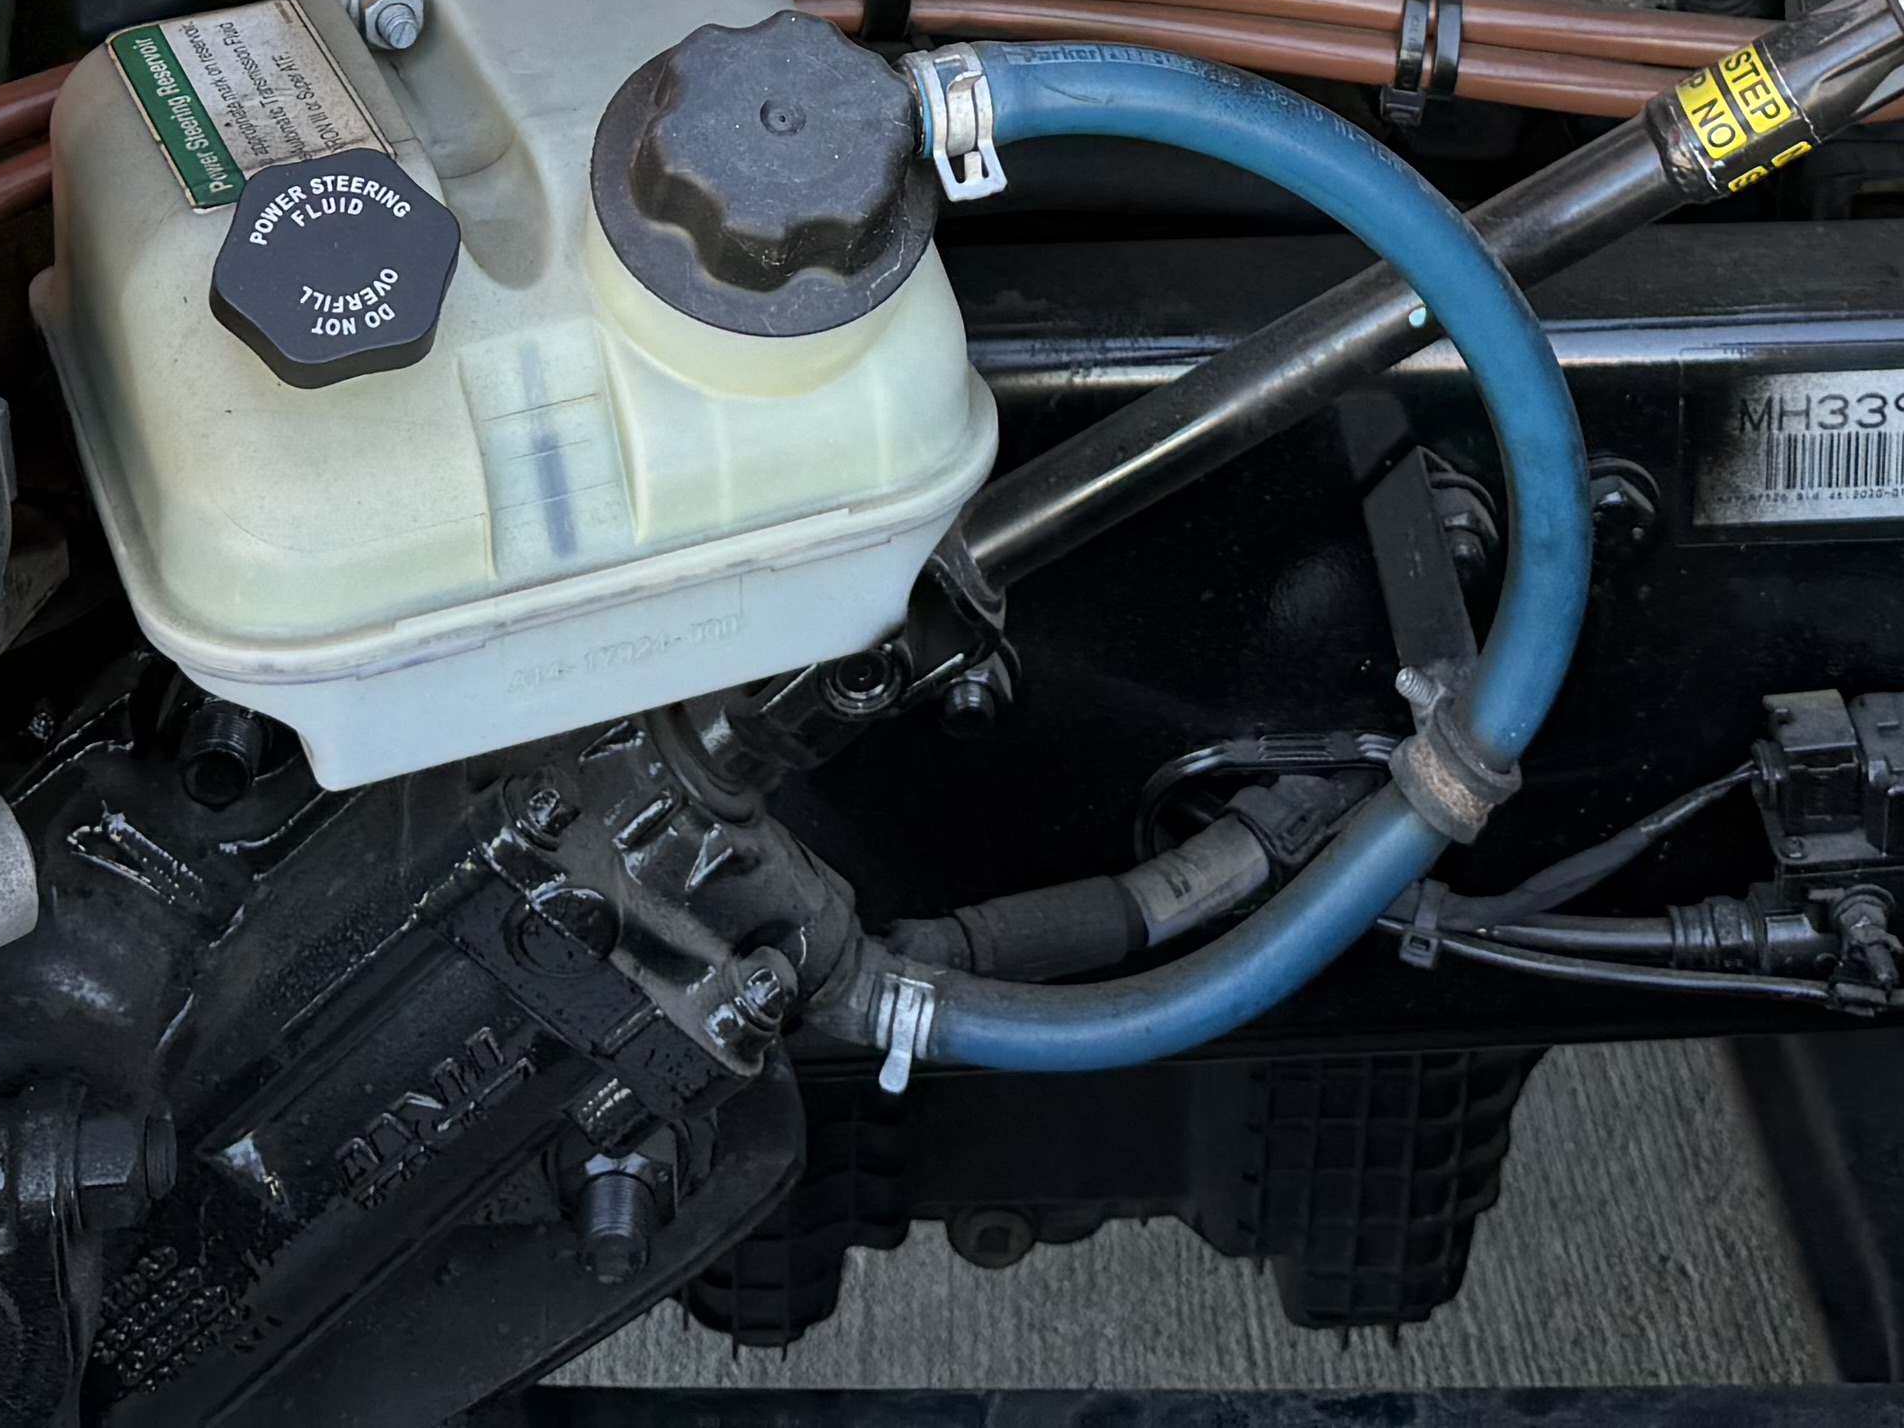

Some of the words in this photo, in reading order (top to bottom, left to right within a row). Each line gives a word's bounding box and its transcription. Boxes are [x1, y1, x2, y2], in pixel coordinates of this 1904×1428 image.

[136, 37, 179, 99] Reservoir
[206, 62, 221, 78] on
[211, 75, 235, 104] mark
[233, 44, 276, 107] Transmission
[1724, 50, 1781, 120] STEP
[168, 93, 210, 152] Steering
[1692, 98, 1736, 148] NO
[197, 149, 233, 194] Power
[249, 184, 307, 247] POWER
[310, 174, 412, 219] STEERING
[291, 196, 363, 228] FLUID
[299, 267, 399, 313] OVERFILL
[311, 316, 356, 336] NOT
[364, 302, 395, 329] DO
